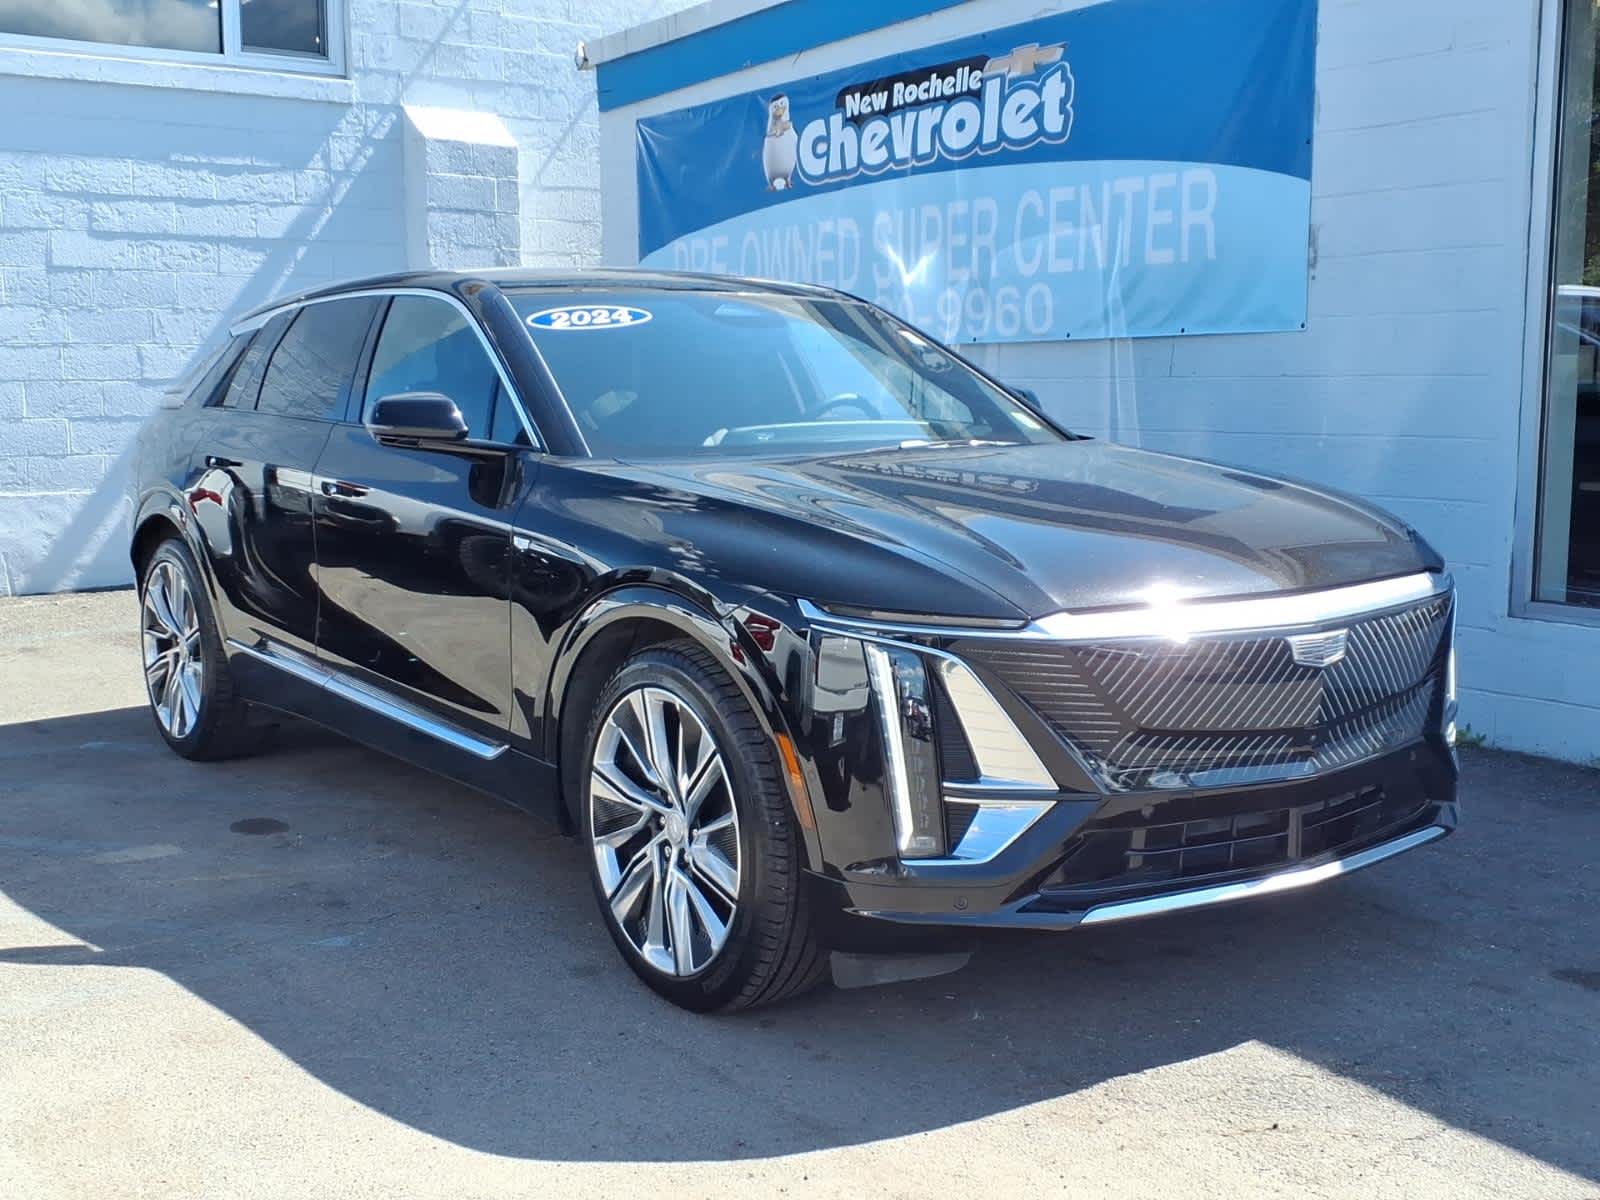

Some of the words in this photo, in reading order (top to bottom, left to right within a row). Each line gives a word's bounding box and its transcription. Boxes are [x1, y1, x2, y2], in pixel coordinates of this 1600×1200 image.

[845, 91, 889, 118] New
[892, 66, 982, 108] Rochelle
[739, 219, 861, 290] OWNED
[872, 196, 999, 290] SUPER
[1012, 168, 1218, 277] CENTER
[551, 309, 633, 328] 2024
